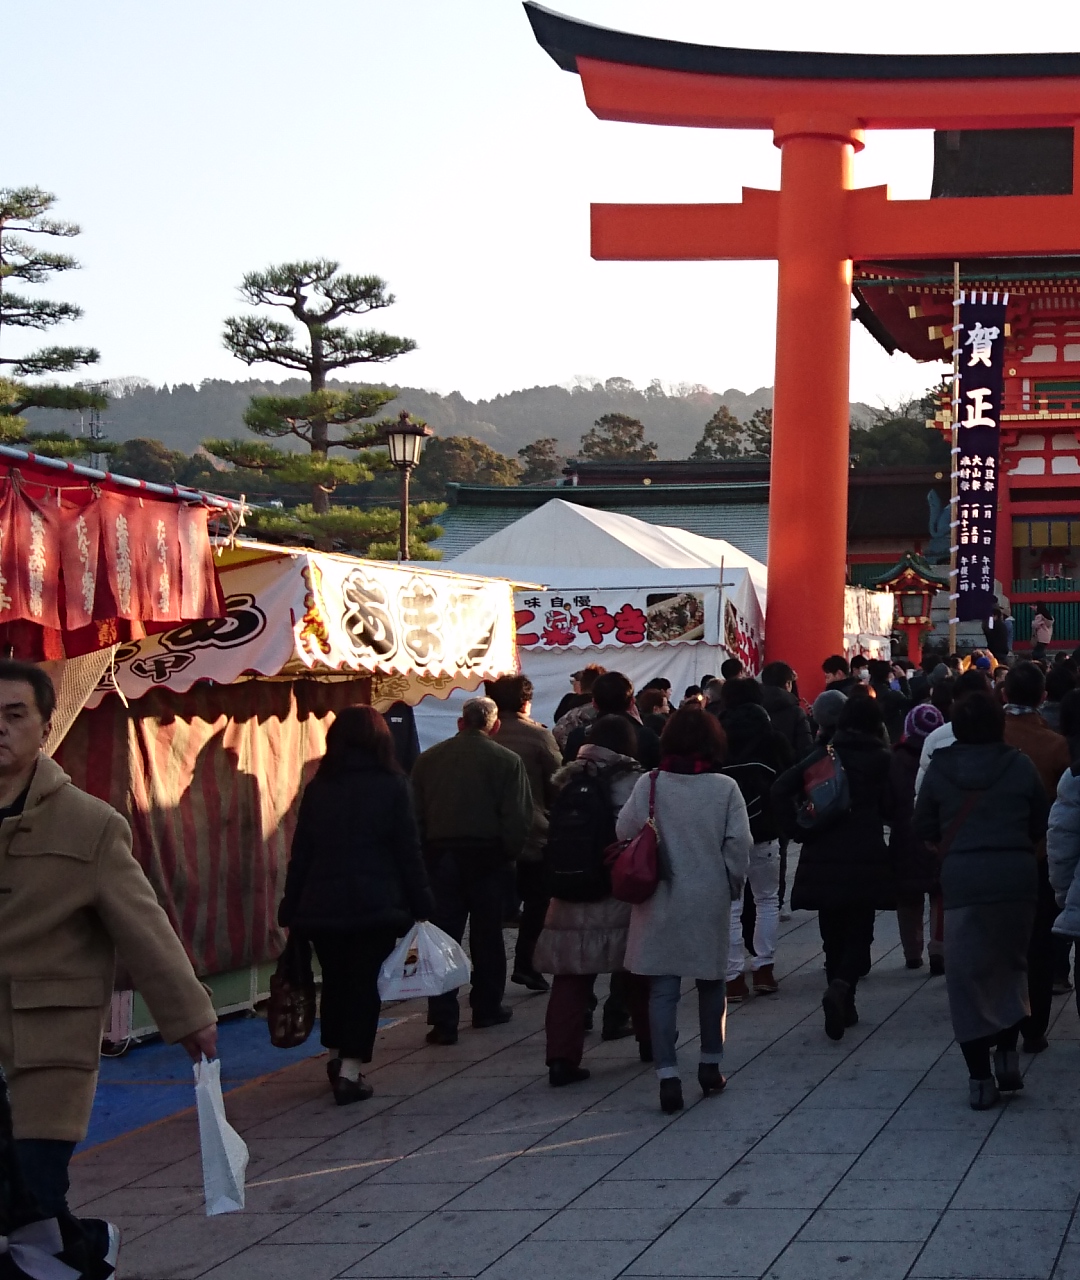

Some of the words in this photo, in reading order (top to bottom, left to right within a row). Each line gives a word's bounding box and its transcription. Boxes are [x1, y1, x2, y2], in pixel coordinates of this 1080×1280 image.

[960, 322, 1000, 429] 賀正
[971, 454, 983, 492] 大山祭
[983, 456, 996, 492] 歳旦祭
[960, 503, 970, 545] 一月十二日
[970, 503, 981, 544] 一月五日
[982, 503, 994, 545] 一月一日
[959, 555, 970, 592] 午後二時
[980, 555, 991, 592] 午前六時
[524, 595, 592, 609] 味自慢
